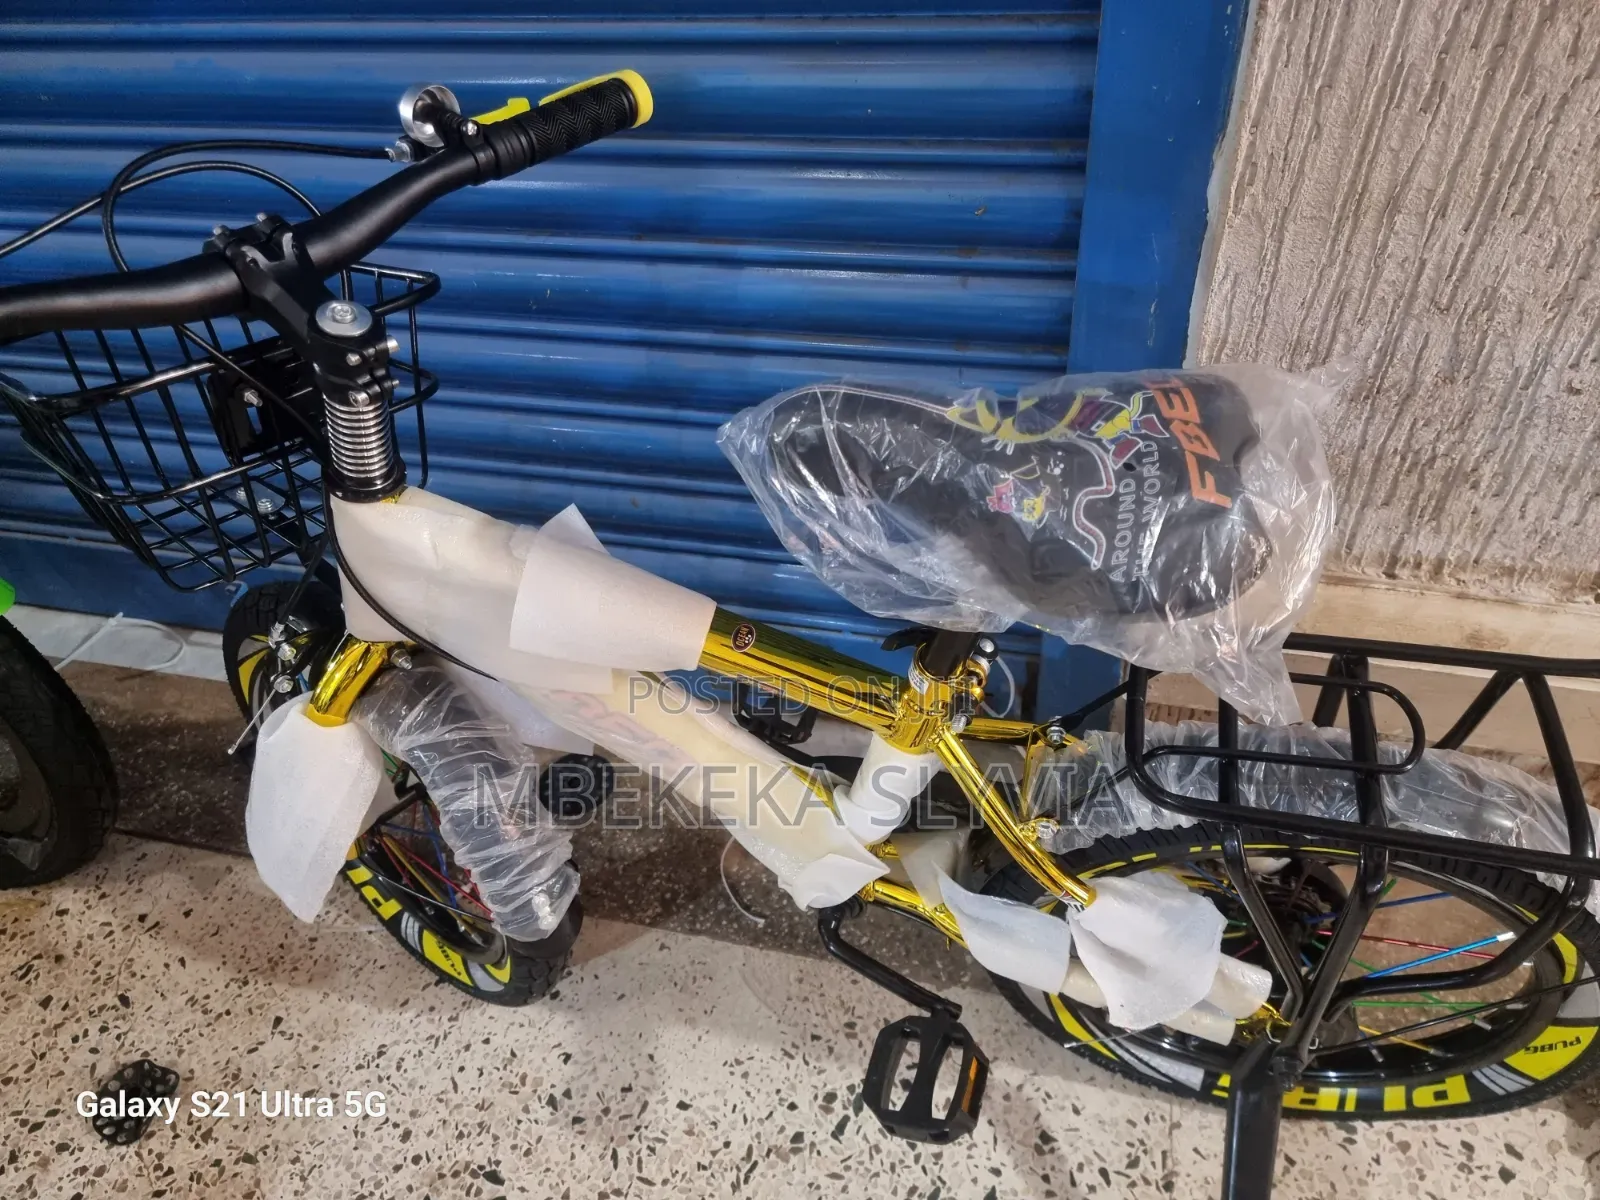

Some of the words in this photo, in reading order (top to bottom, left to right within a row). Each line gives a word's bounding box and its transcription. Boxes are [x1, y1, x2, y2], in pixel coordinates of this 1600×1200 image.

[1141, 440, 1163, 523] WORLD
[1109, 478, 1136, 583] AROUND
[735, 626, 750, 647] OCEAN
[1523, 1035, 1582, 1055] PUBG
